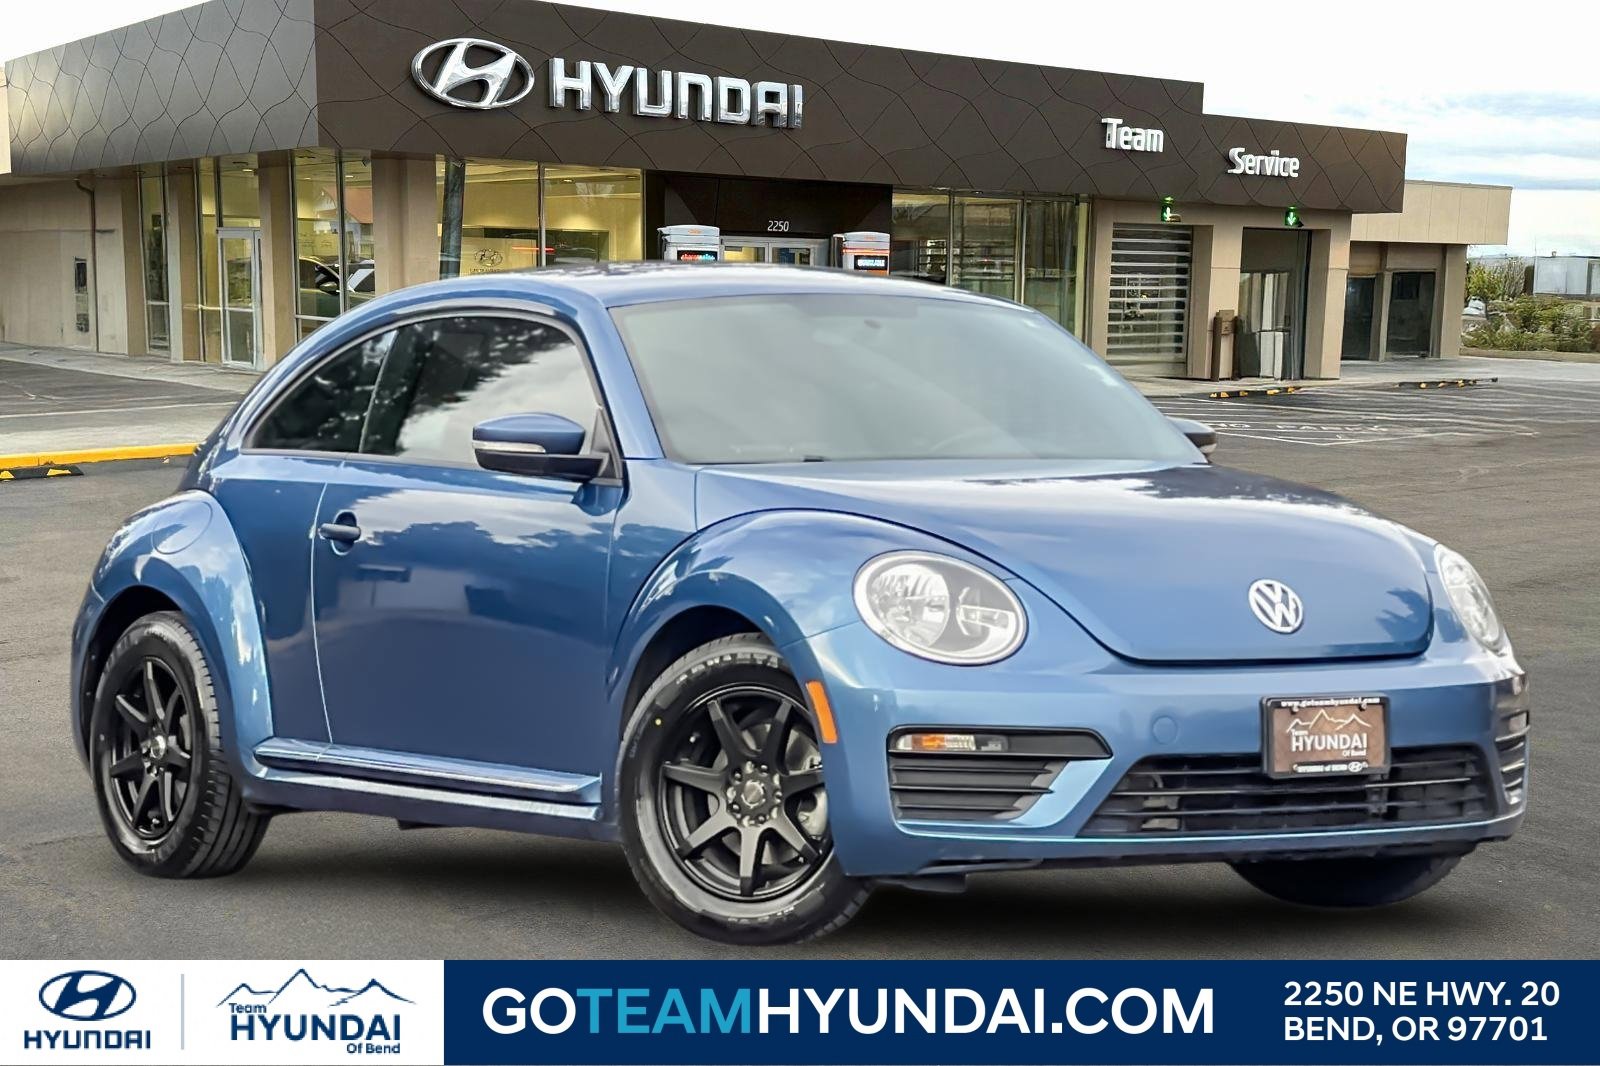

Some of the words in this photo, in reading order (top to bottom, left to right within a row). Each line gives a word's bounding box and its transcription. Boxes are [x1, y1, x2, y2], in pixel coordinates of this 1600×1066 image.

[549, 57, 804, 129] HYUNDAI
[1101, 117, 1164, 152] Team
[1227, 147, 1300, 178] Service
[767, 220, 790, 232] 2250
[1291, 732, 1368, 752] HYUNDAI
